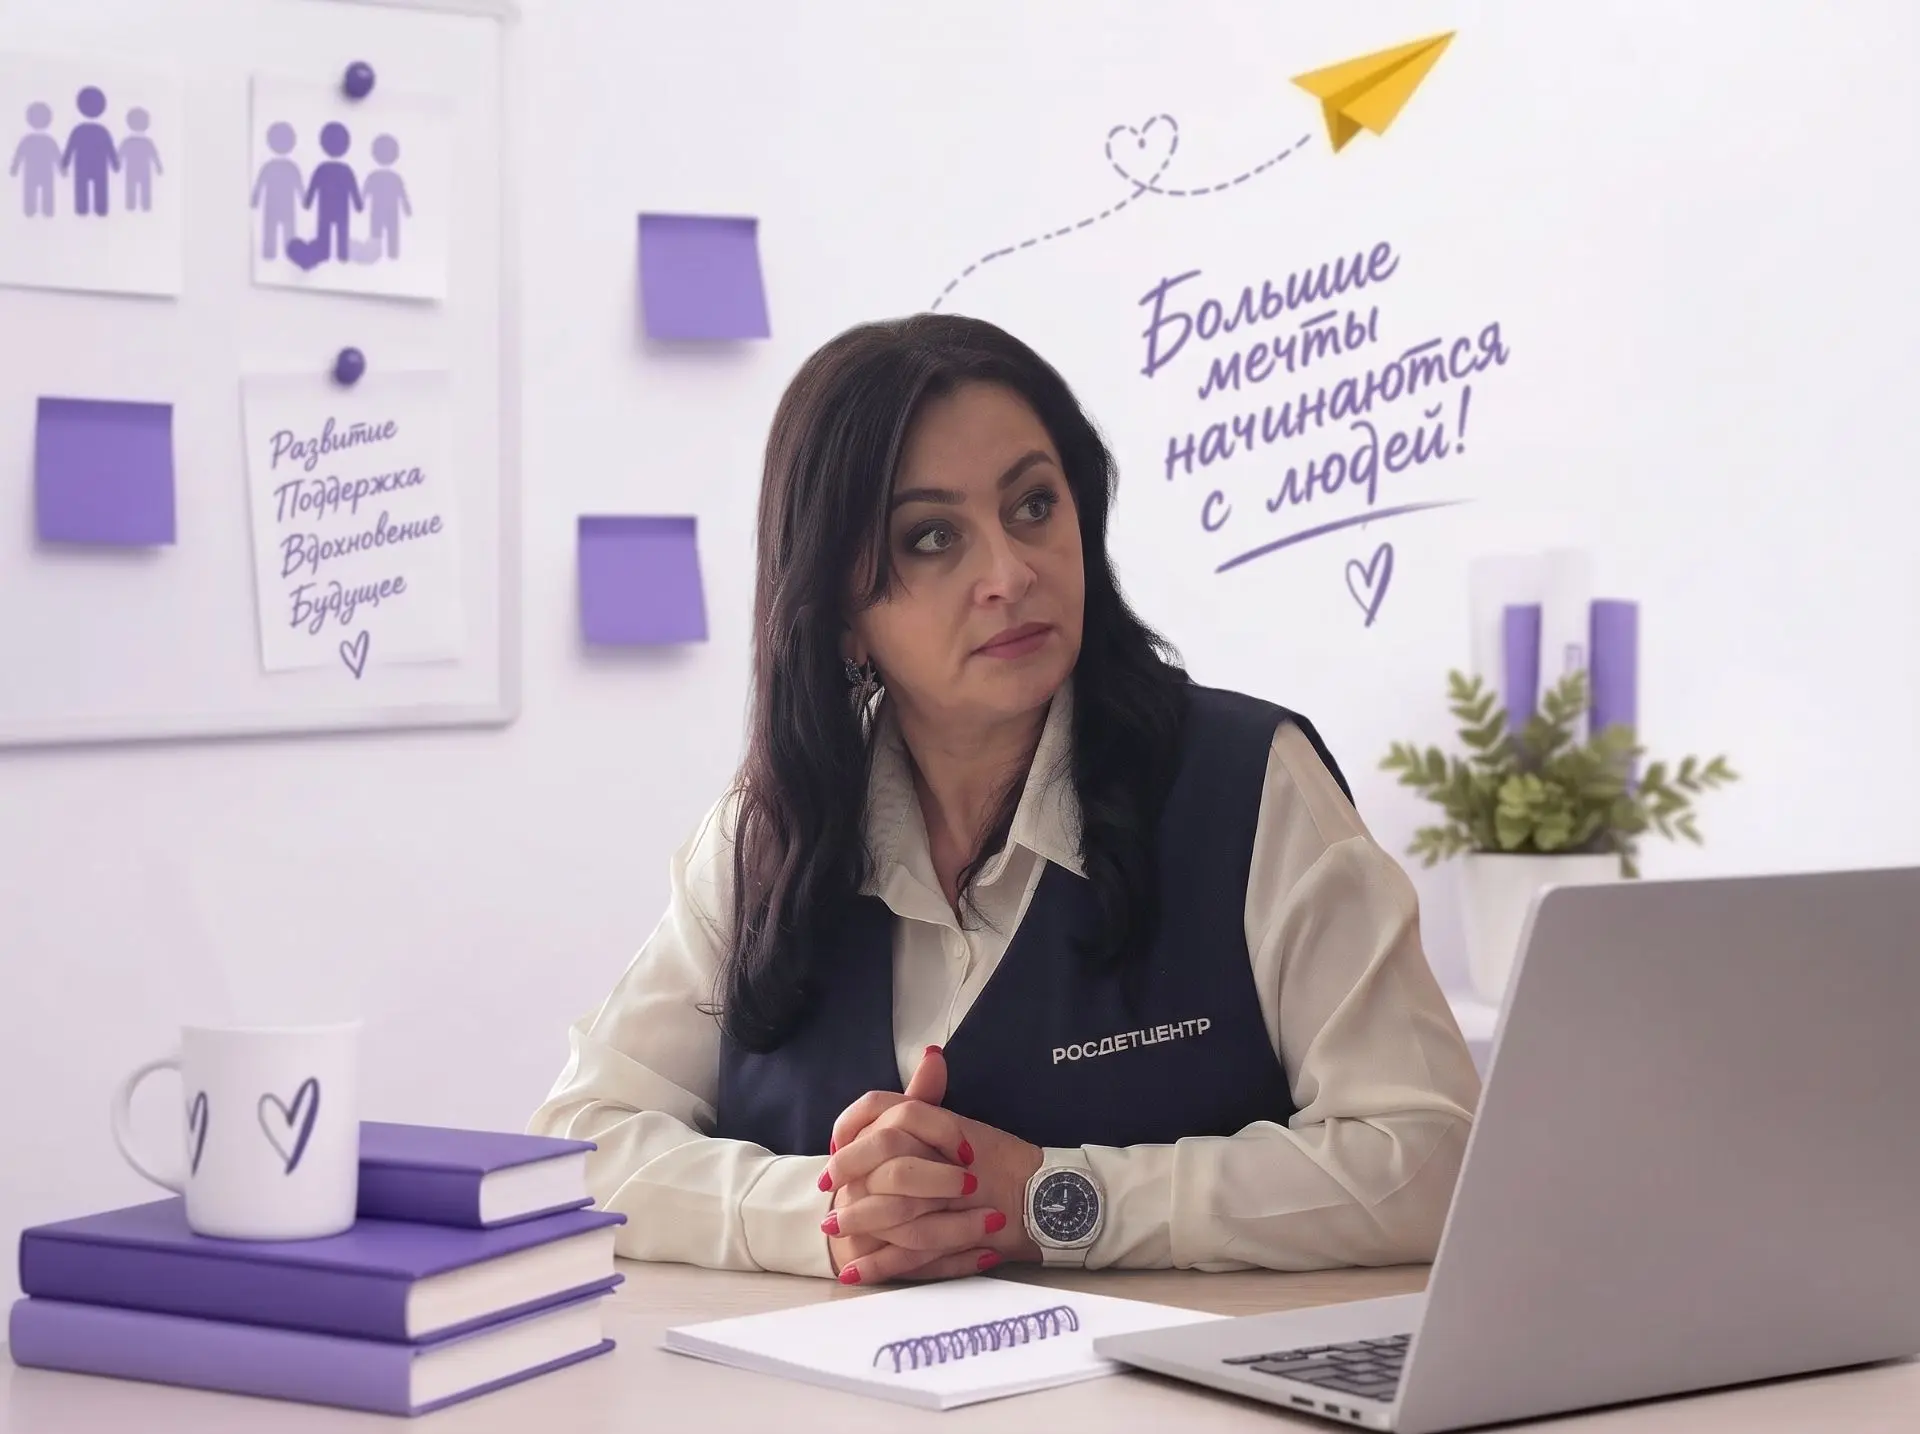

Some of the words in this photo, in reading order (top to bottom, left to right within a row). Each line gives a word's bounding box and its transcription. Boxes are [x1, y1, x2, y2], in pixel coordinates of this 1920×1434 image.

[1138, 241, 1399, 378] Большие
[1198, 306, 1379, 400] мечты
[1164, 321, 1510, 481] начинаются
[270, 417, 398, 472] Развитие
[1201, 489, 1231, 532] с
[1266, 384, 1472, 513] людей!
[274, 465, 425, 523] Поддержка
[280, 510, 443, 578] Вдохновение
[289, 575, 407, 635] Будущее
[1052, 1017, 1212, 1065] РОСДЕТЦЕНТР
